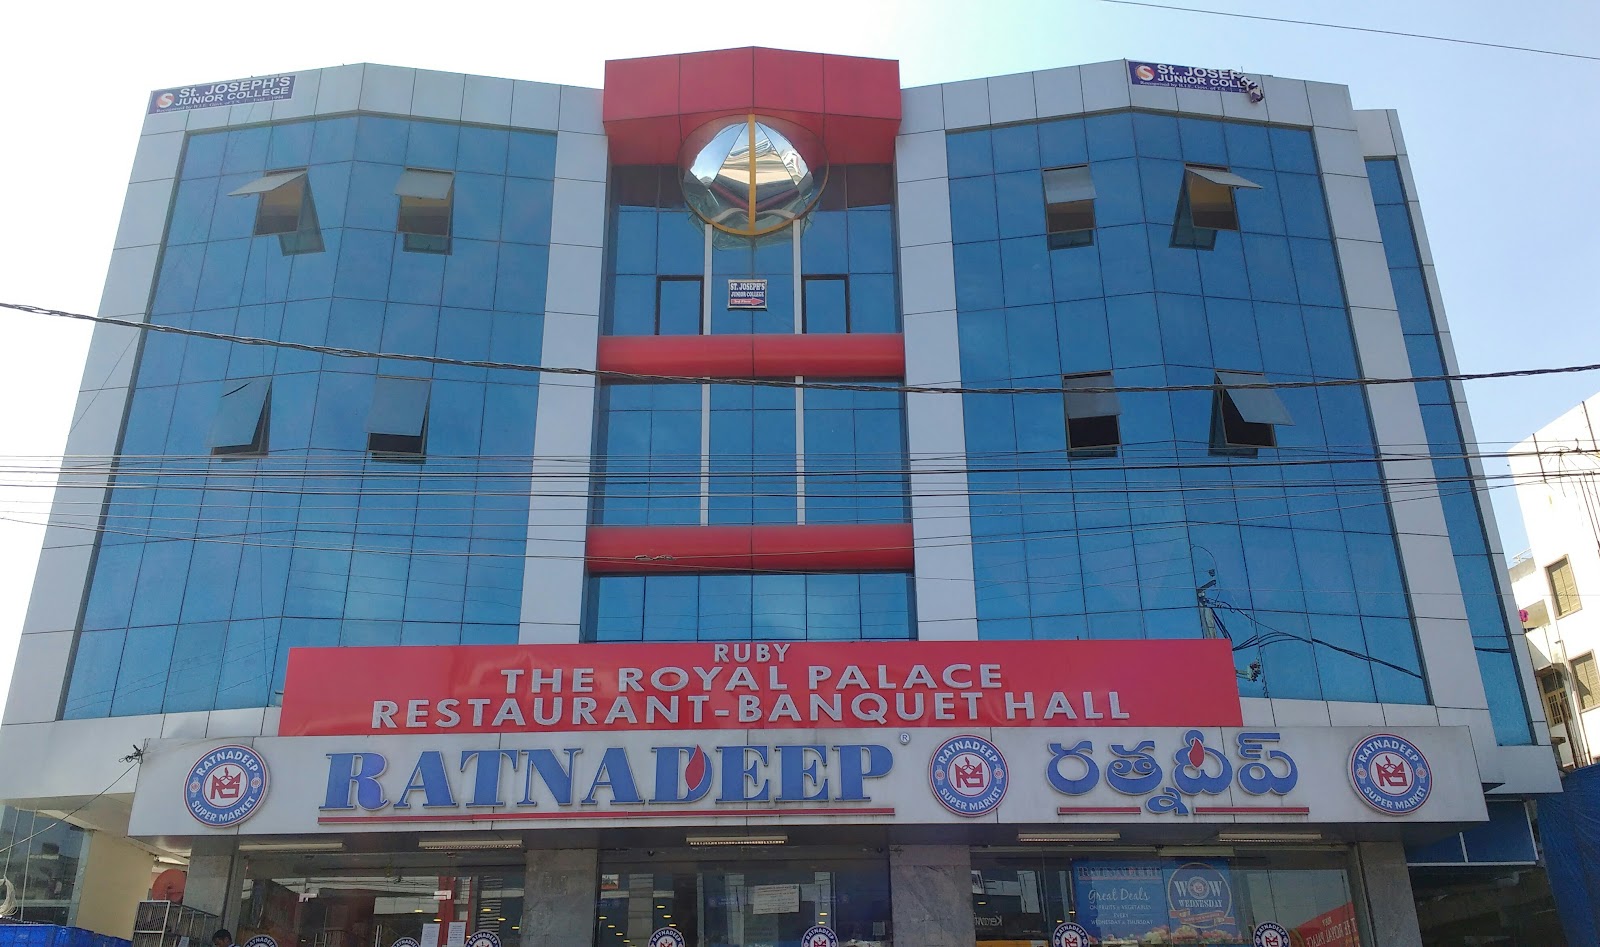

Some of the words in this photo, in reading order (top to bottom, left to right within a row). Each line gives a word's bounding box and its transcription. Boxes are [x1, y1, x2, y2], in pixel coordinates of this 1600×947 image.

[1157, 64, 1179, 75] St.
[1158, 74, 1207, 85] JUNIOR
[175, 94, 223, 106] JUNIOR
[227, 87, 289, 100] COLLEGE
[179, 88, 199, 98] St.
[205, 76, 291, 95] JOSEPH'S
[714, 643, 790, 664] RUBY
[500, 668, 595, 694] THE
[618, 666, 788, 692] ROYAL
[808, 663, 1002, 690] PALACE
[1005, 691, 1130, 720] HALL
[196, 750, 259, 776] RATNADEEP
[938, 741, 998, 764] RATNADEEP
[1358, 740, 1419, 763] RATNADEEP
[318, 743, 895, 811] RATNADEEP
[940, 788, 967, 810] SUPER
[969, 786, 1002, 810] MARKET
[1364, 786, 1393, 809] SUPER
[1395, 785, 1426, 809] MARKET
[192, 800, 217, 821] SUPER
[219, 796, 255, 822] MARKET
[1088, 888, 1118, 904] Great
[1120, 887, 1151, 901] Deals
[1178, 900, 1223, 908] WEDNESDAY
